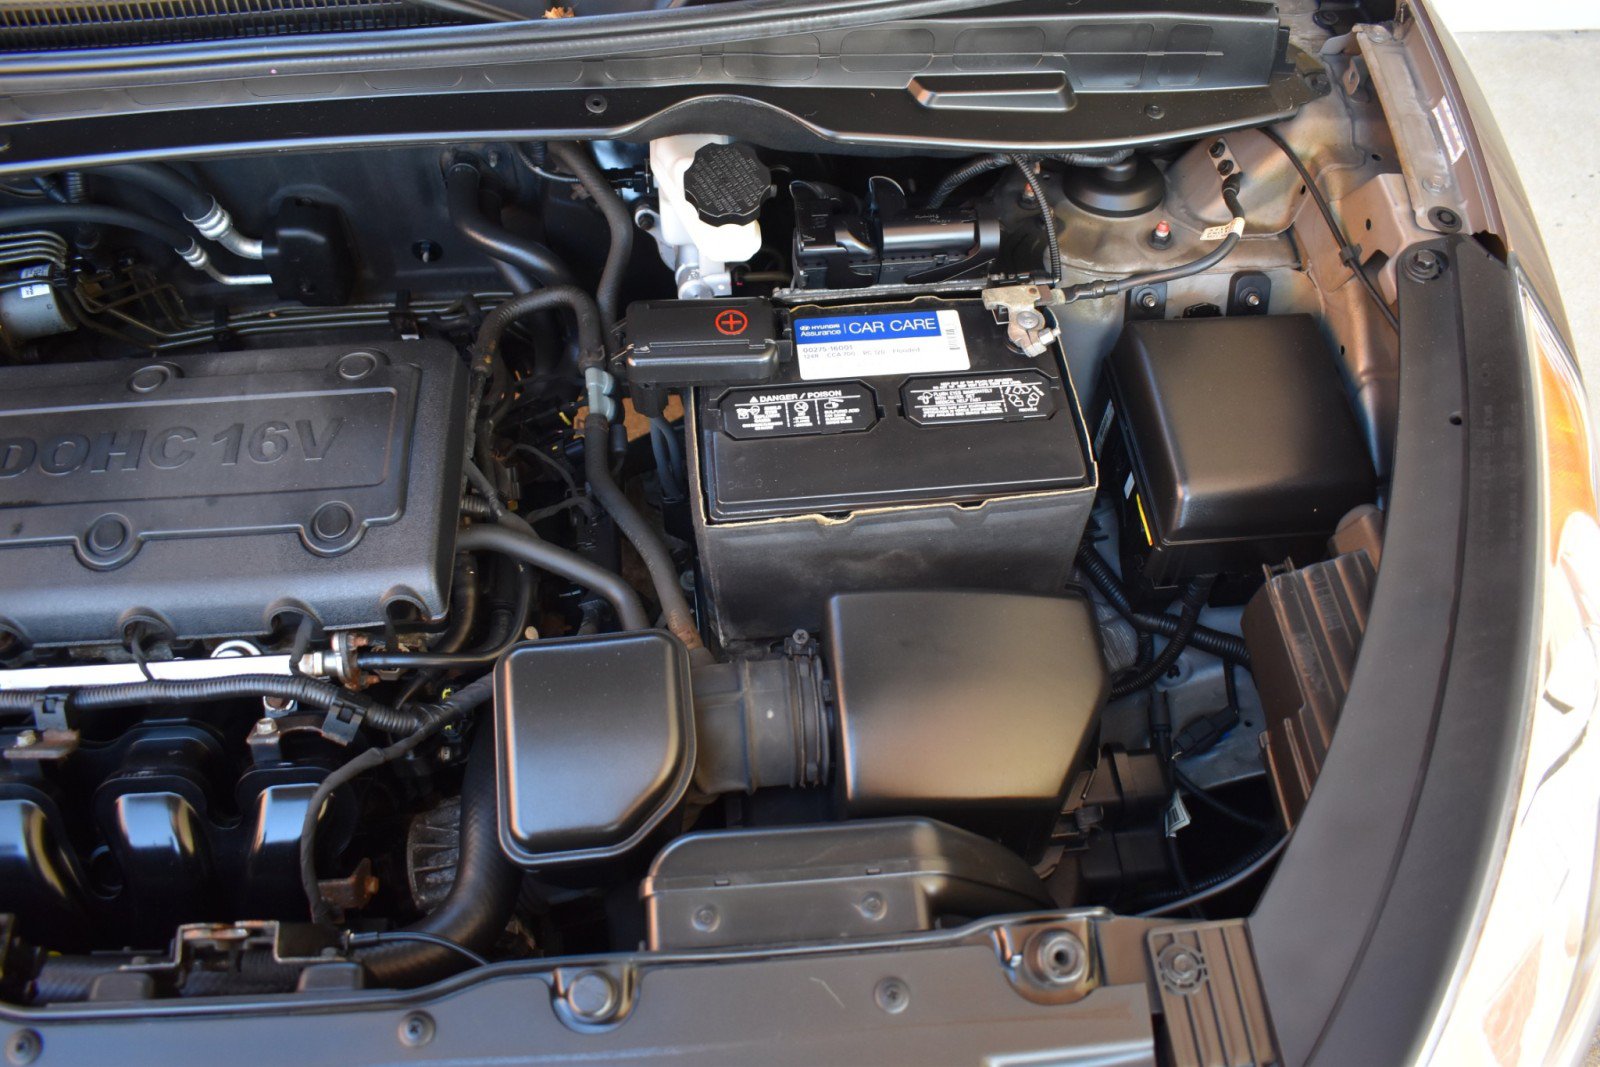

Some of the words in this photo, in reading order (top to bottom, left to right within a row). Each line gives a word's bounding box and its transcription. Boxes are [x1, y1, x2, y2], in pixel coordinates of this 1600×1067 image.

[800, 329, 841, 337] Assurance
[848, 321, 885, 335] CAR
[889, 318, 937, 332] CARE
[759, 393, 798, 402] DANGER
[807, 390, 842, 398] POISON
[0, 426, 198, 478] DOHC
[211, 418, 346, 467] 16V
